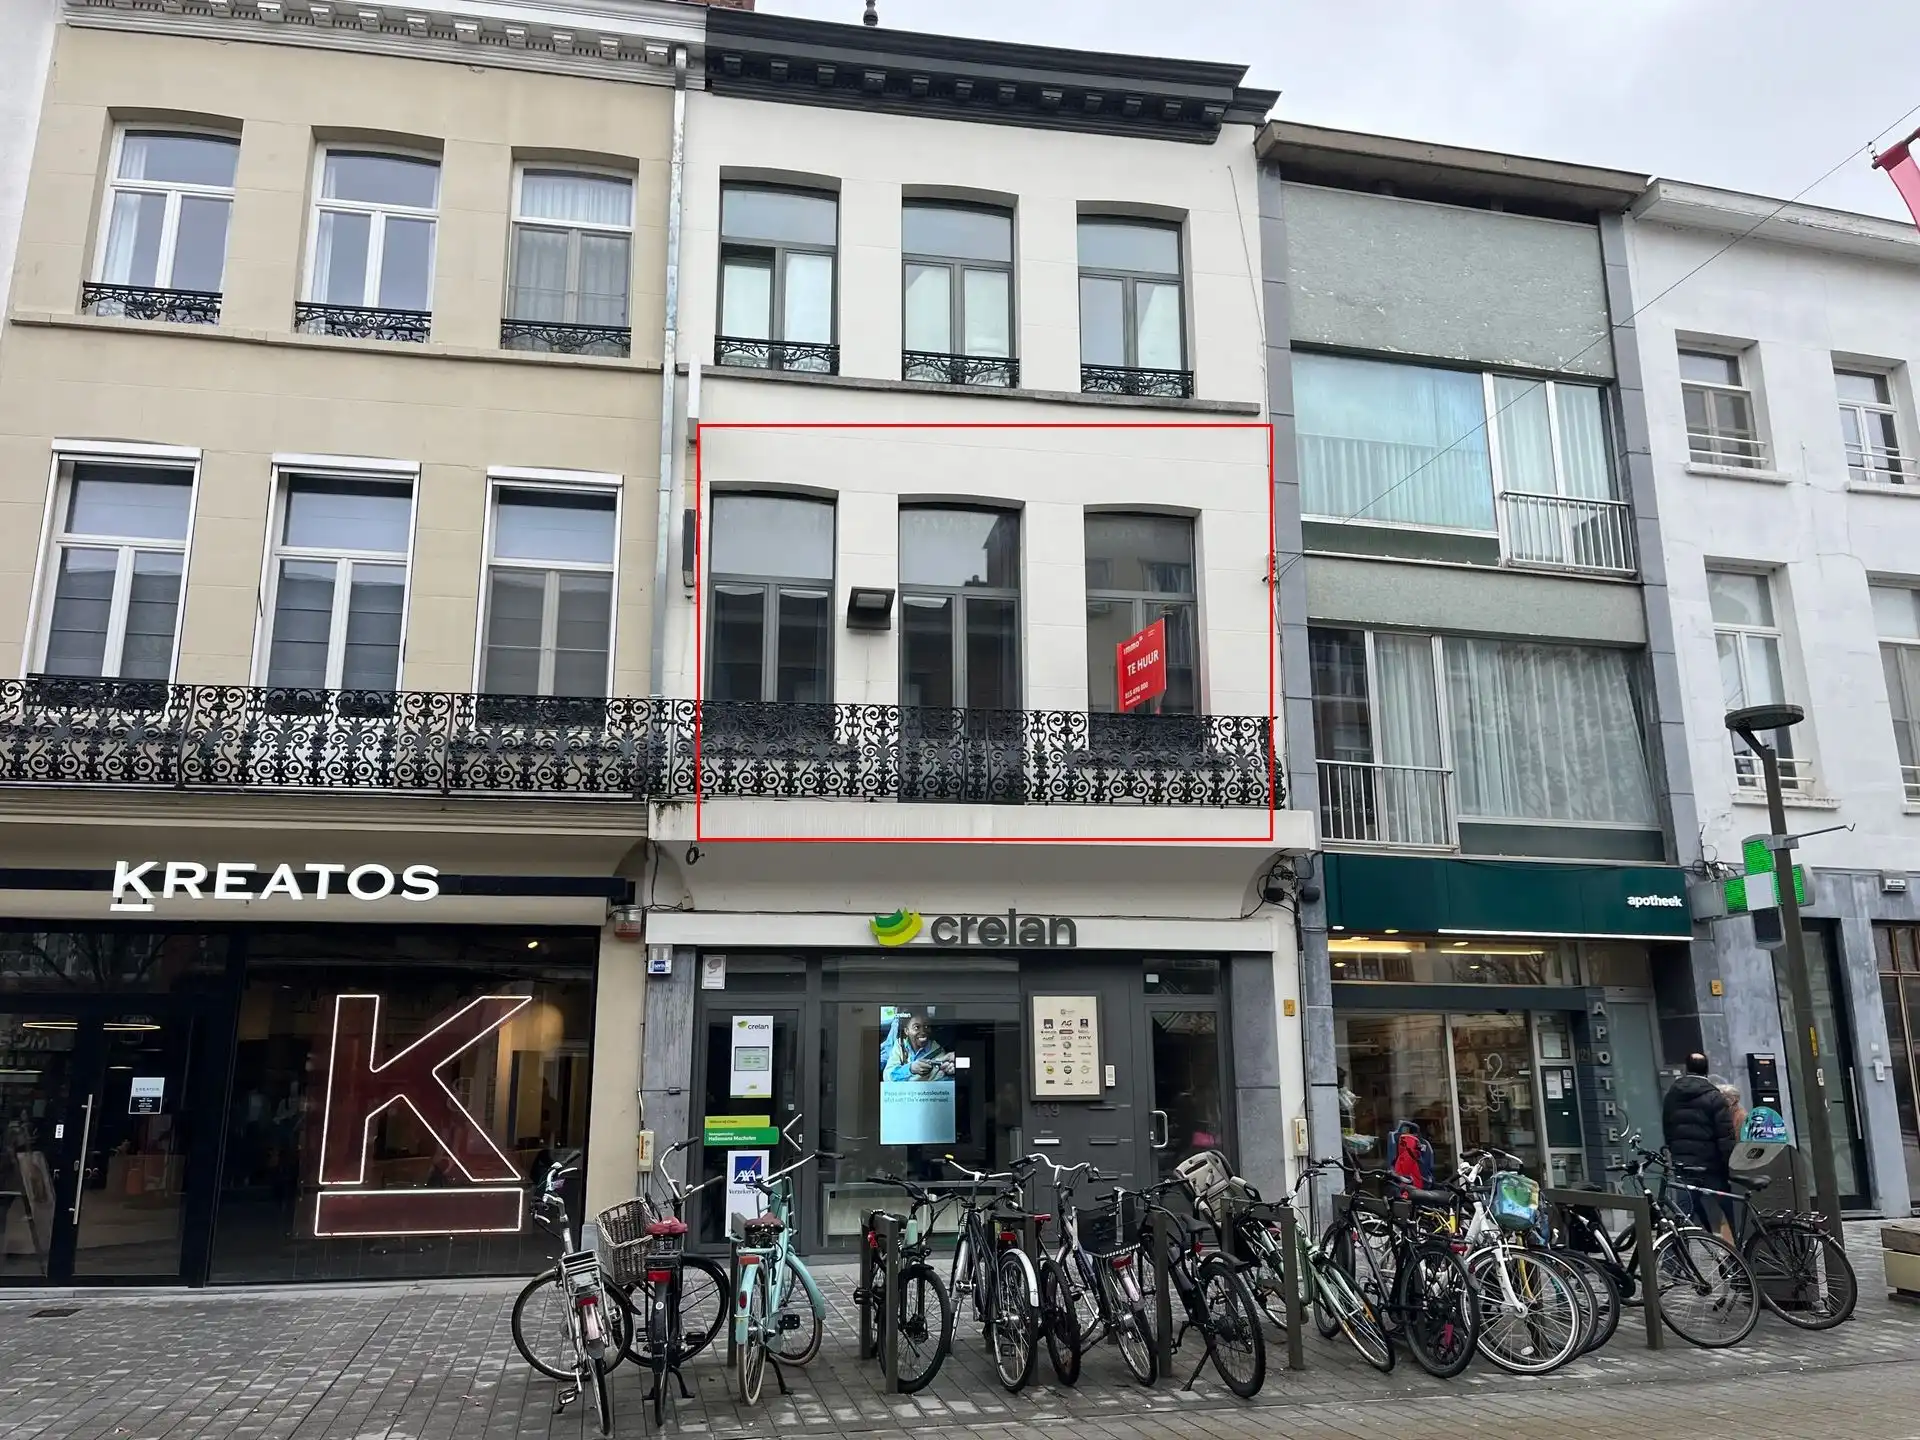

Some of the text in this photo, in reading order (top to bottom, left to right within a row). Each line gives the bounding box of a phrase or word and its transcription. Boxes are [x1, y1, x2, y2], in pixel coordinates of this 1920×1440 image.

[1127, 649, 1159, 676] TE HUUR
[111, 860, 440, 904] KREATOS
[1627, 894, 1683, 908] apotheek
[931, 908, 1077, 947] crelan
[319, 995, 532, 1185] K
[734, 1169, 757, 1182] AXA
